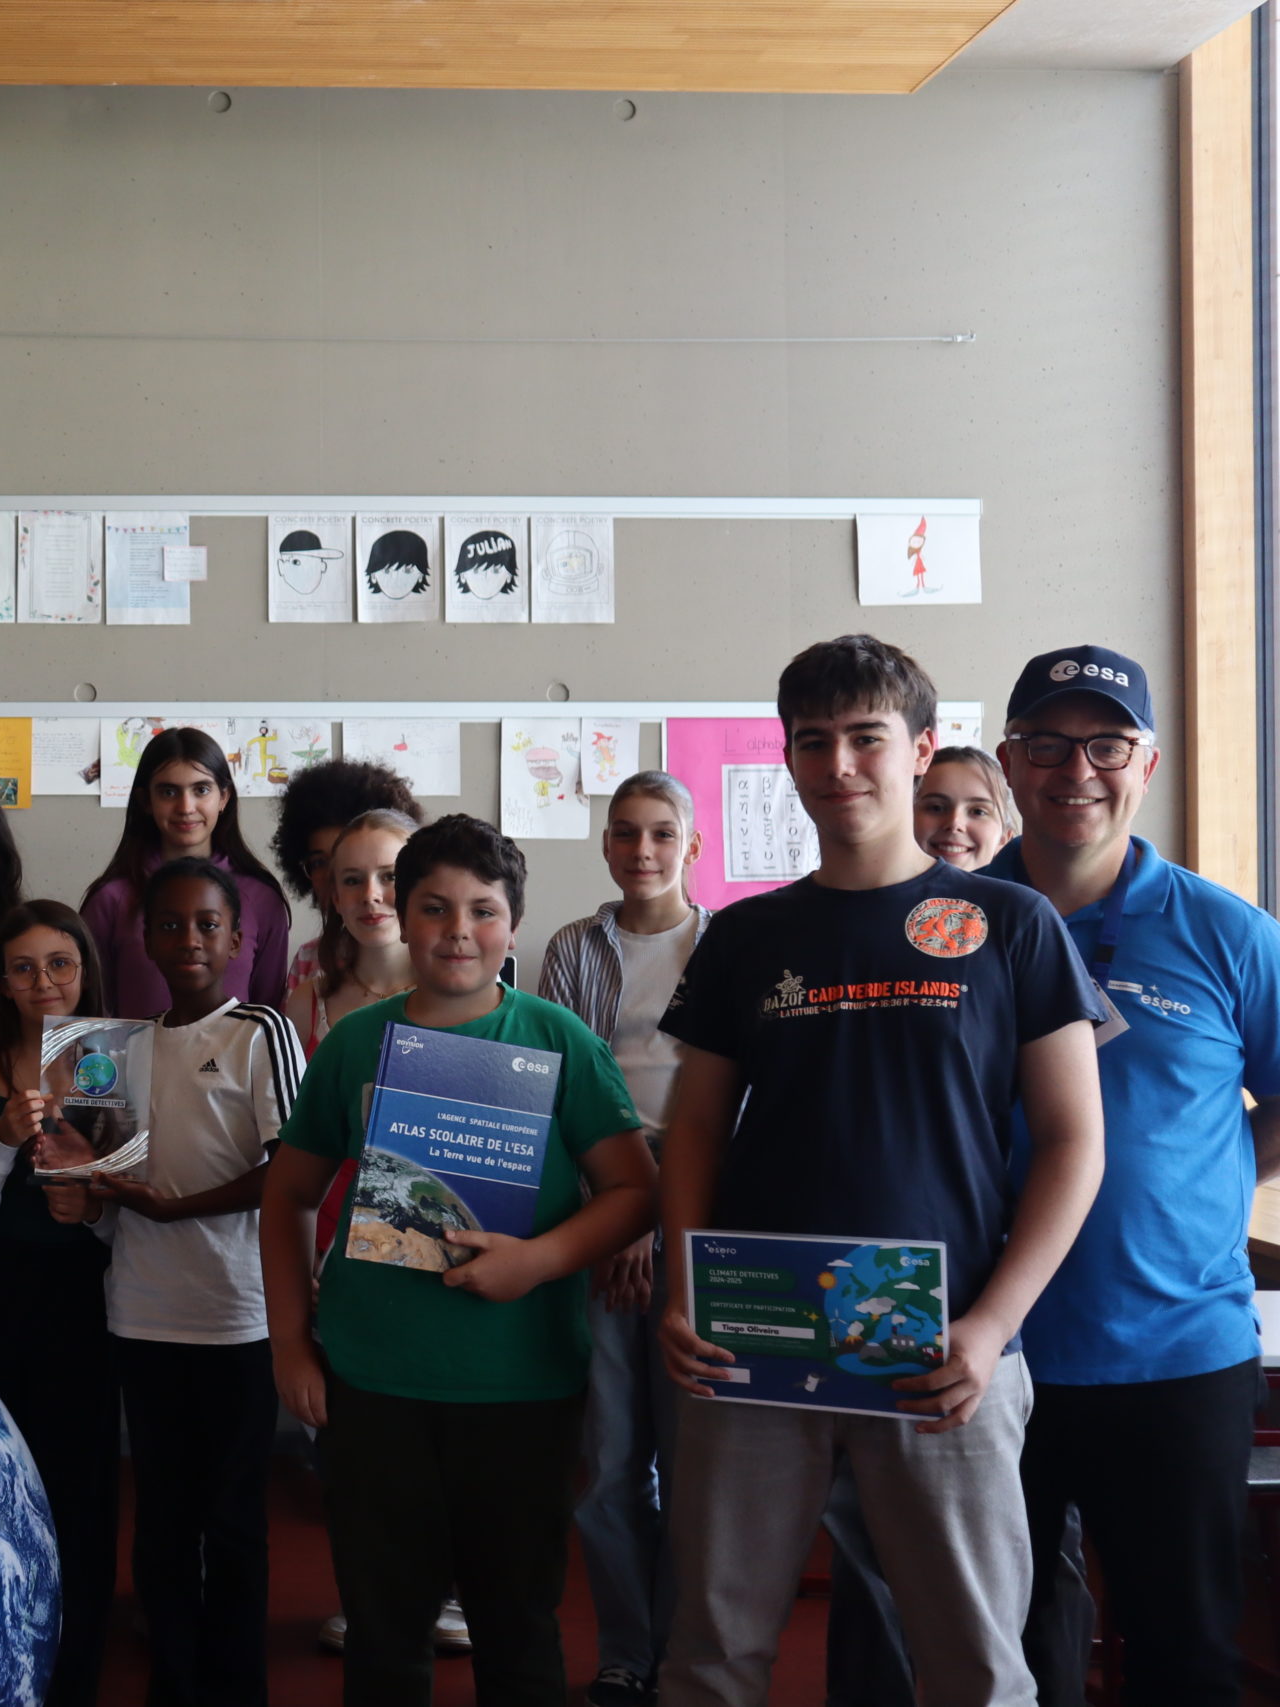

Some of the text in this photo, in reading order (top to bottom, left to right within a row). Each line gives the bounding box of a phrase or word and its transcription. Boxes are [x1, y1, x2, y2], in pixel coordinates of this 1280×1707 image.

[361, 516, 433, 524] CONCRETE POETRY
[467, 537, 512, 559] JULIAN
[1082, 663, 1129, 687] esa
[746, 736, 786, 755] alphabe
[847, 982, 891, 1000] VERDE
[780, 1006, 820, 1018] LATITUDE
[1140, 994, 1191, 1015] esero
[527, 1061, 549, 1074] esa
[90, 1099, 124, 1107] DETECTIVES
[437, 1112, 466, 1124] L'AGENCE
[469, 1118, 501, 1130] SPATIALE
[389, 1121, 534, 1156] ATLAS SCOLAIRE DE L'ESA
[429, 1146, 532, 1173] La Terre vue de l'espace
[708, 1247, 737, 1255] esero
[709, 1269, 780, 1280] CLIMATE DETECTIVES
[722, 1324, 780, 1335] Tiago Oliveira
